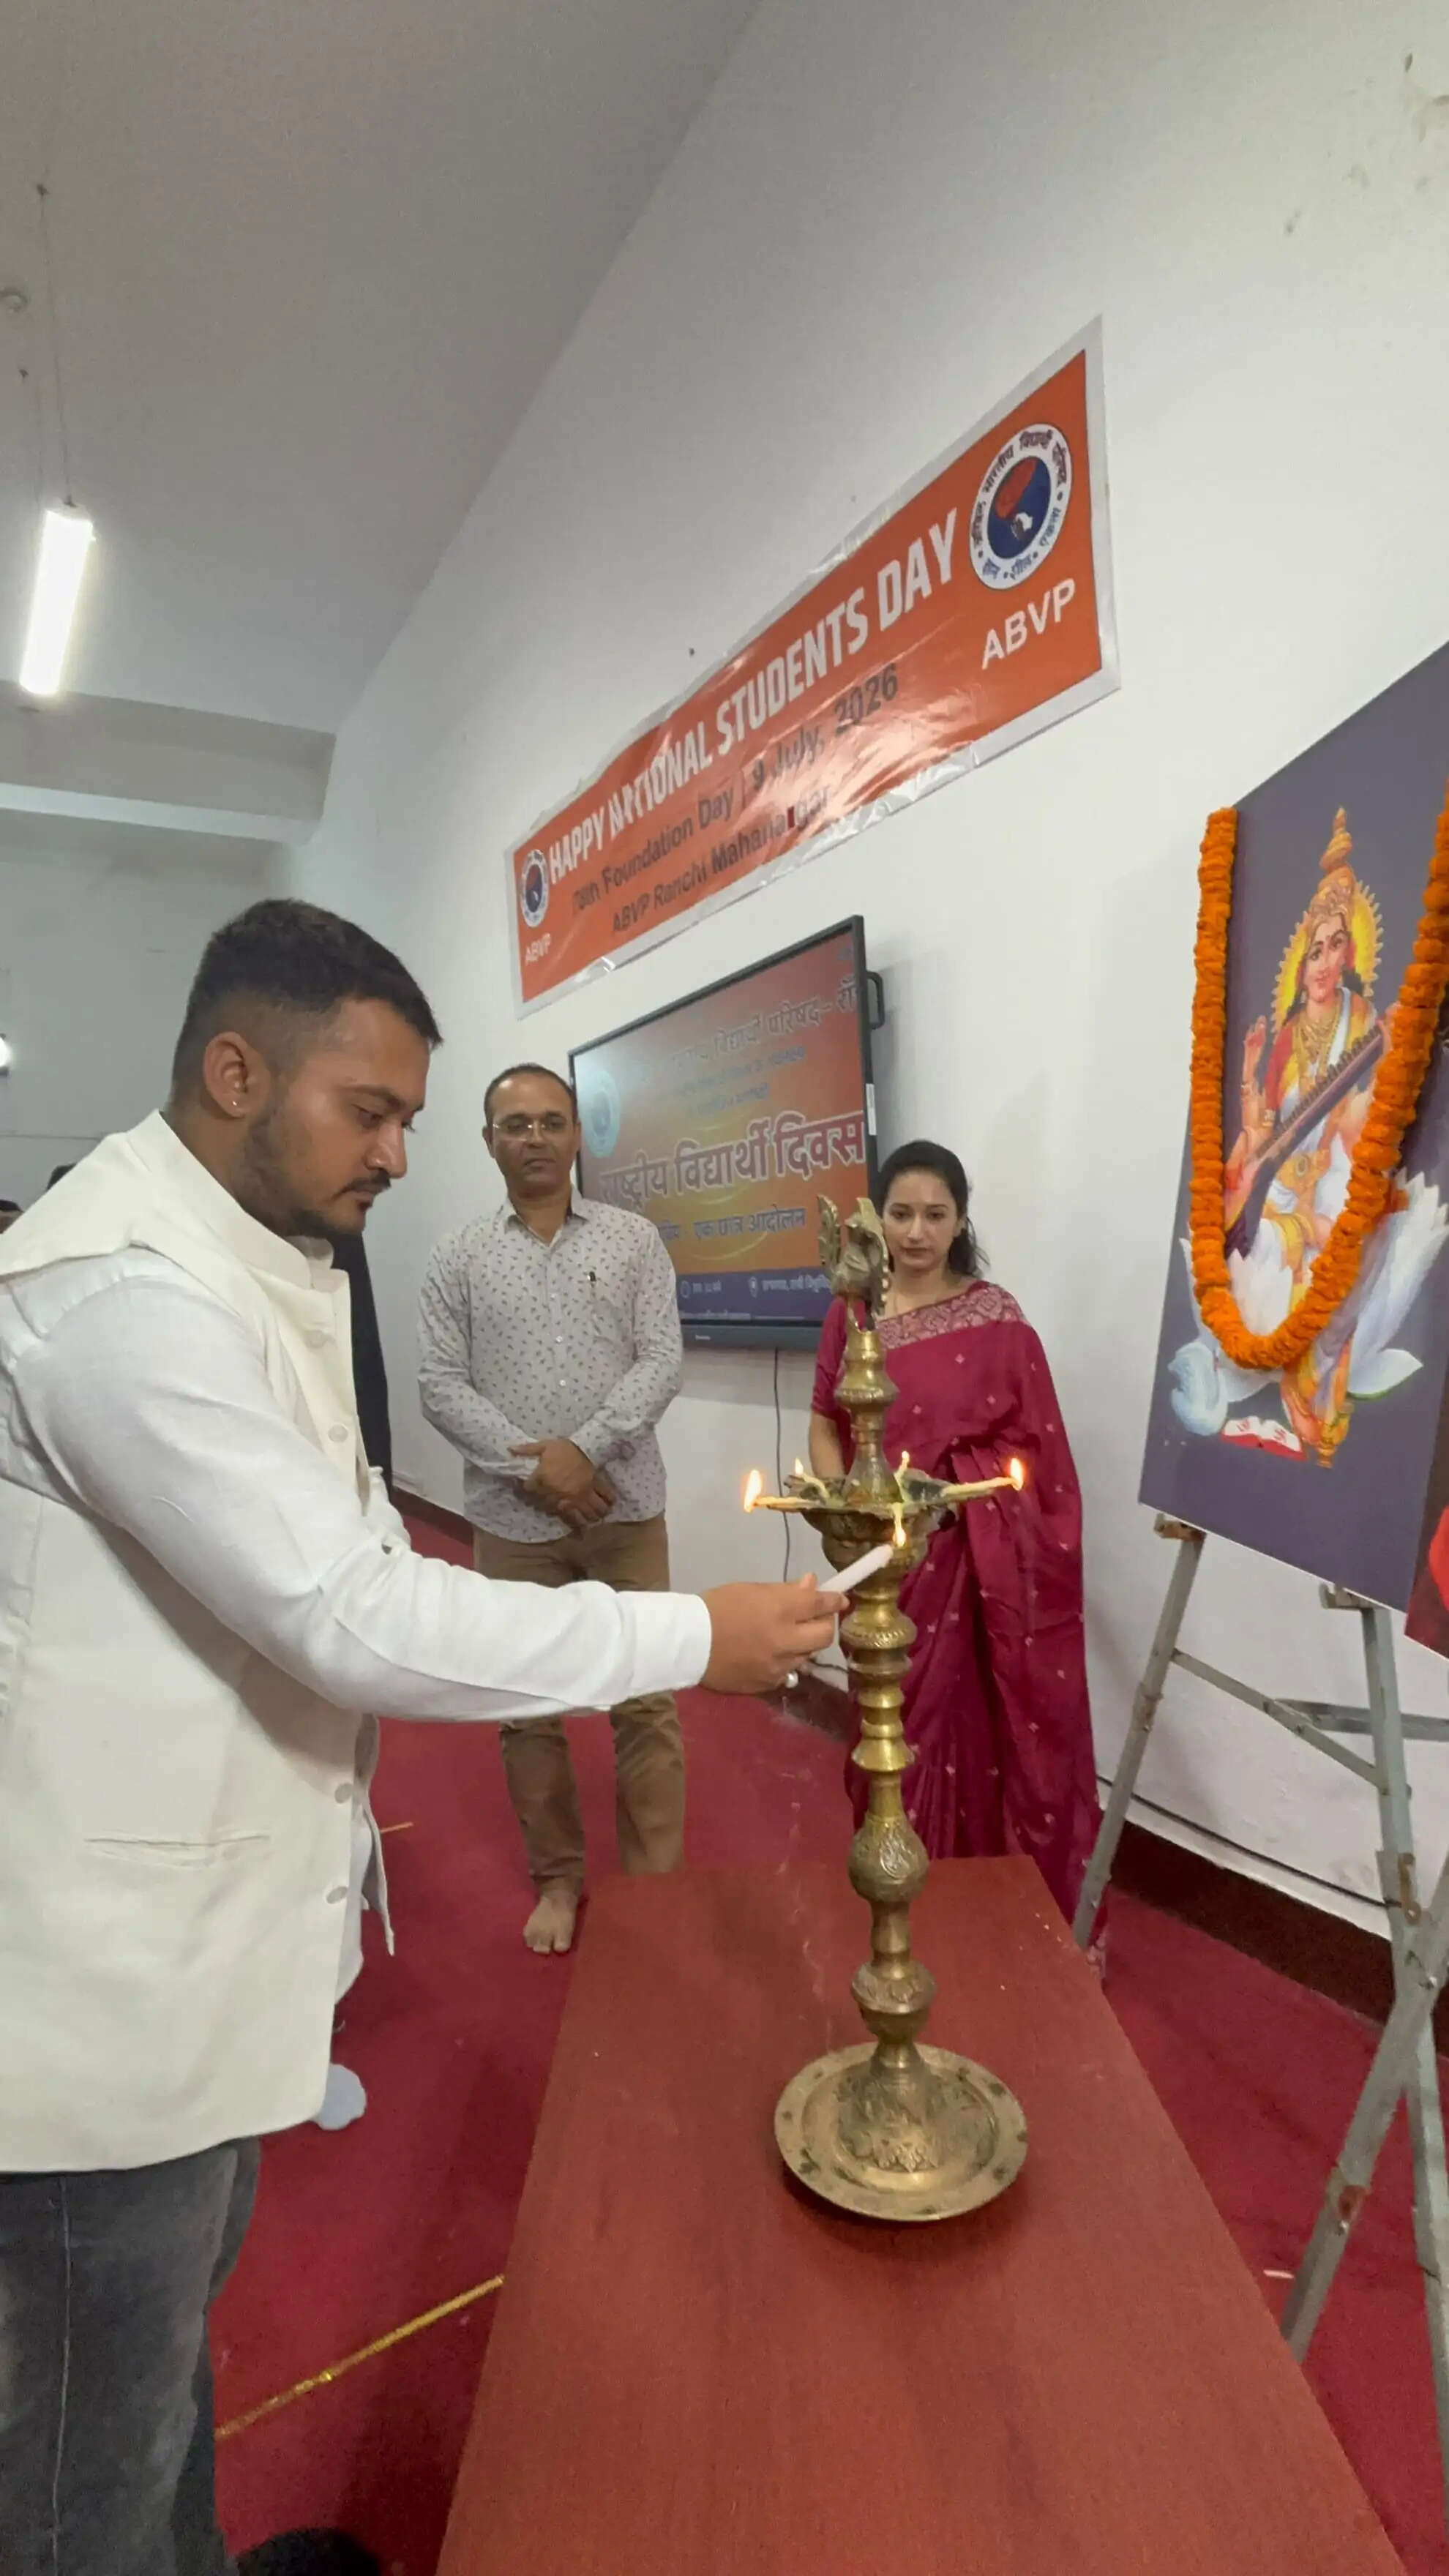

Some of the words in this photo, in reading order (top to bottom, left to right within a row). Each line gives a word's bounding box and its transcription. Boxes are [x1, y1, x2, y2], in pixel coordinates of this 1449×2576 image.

[981, 577, 1075, 670] ABVP
[549, 806, 604, 885] HAPPY
[716, 586, 869, 756] STUDENTS
[877, 507, 957, 632] DAY
[602, 816, 694, 894] Foundation
[698, 785, 733, 829] Day
[834, 662, 898, 735] 2026
[613, 892, 651, 932] ABVP
[654, 859, 708, 909] Ranchi
[674, 1116, 771, 1194] विद्यार्थी
[773, 1109, 866, 1180] दिवस
